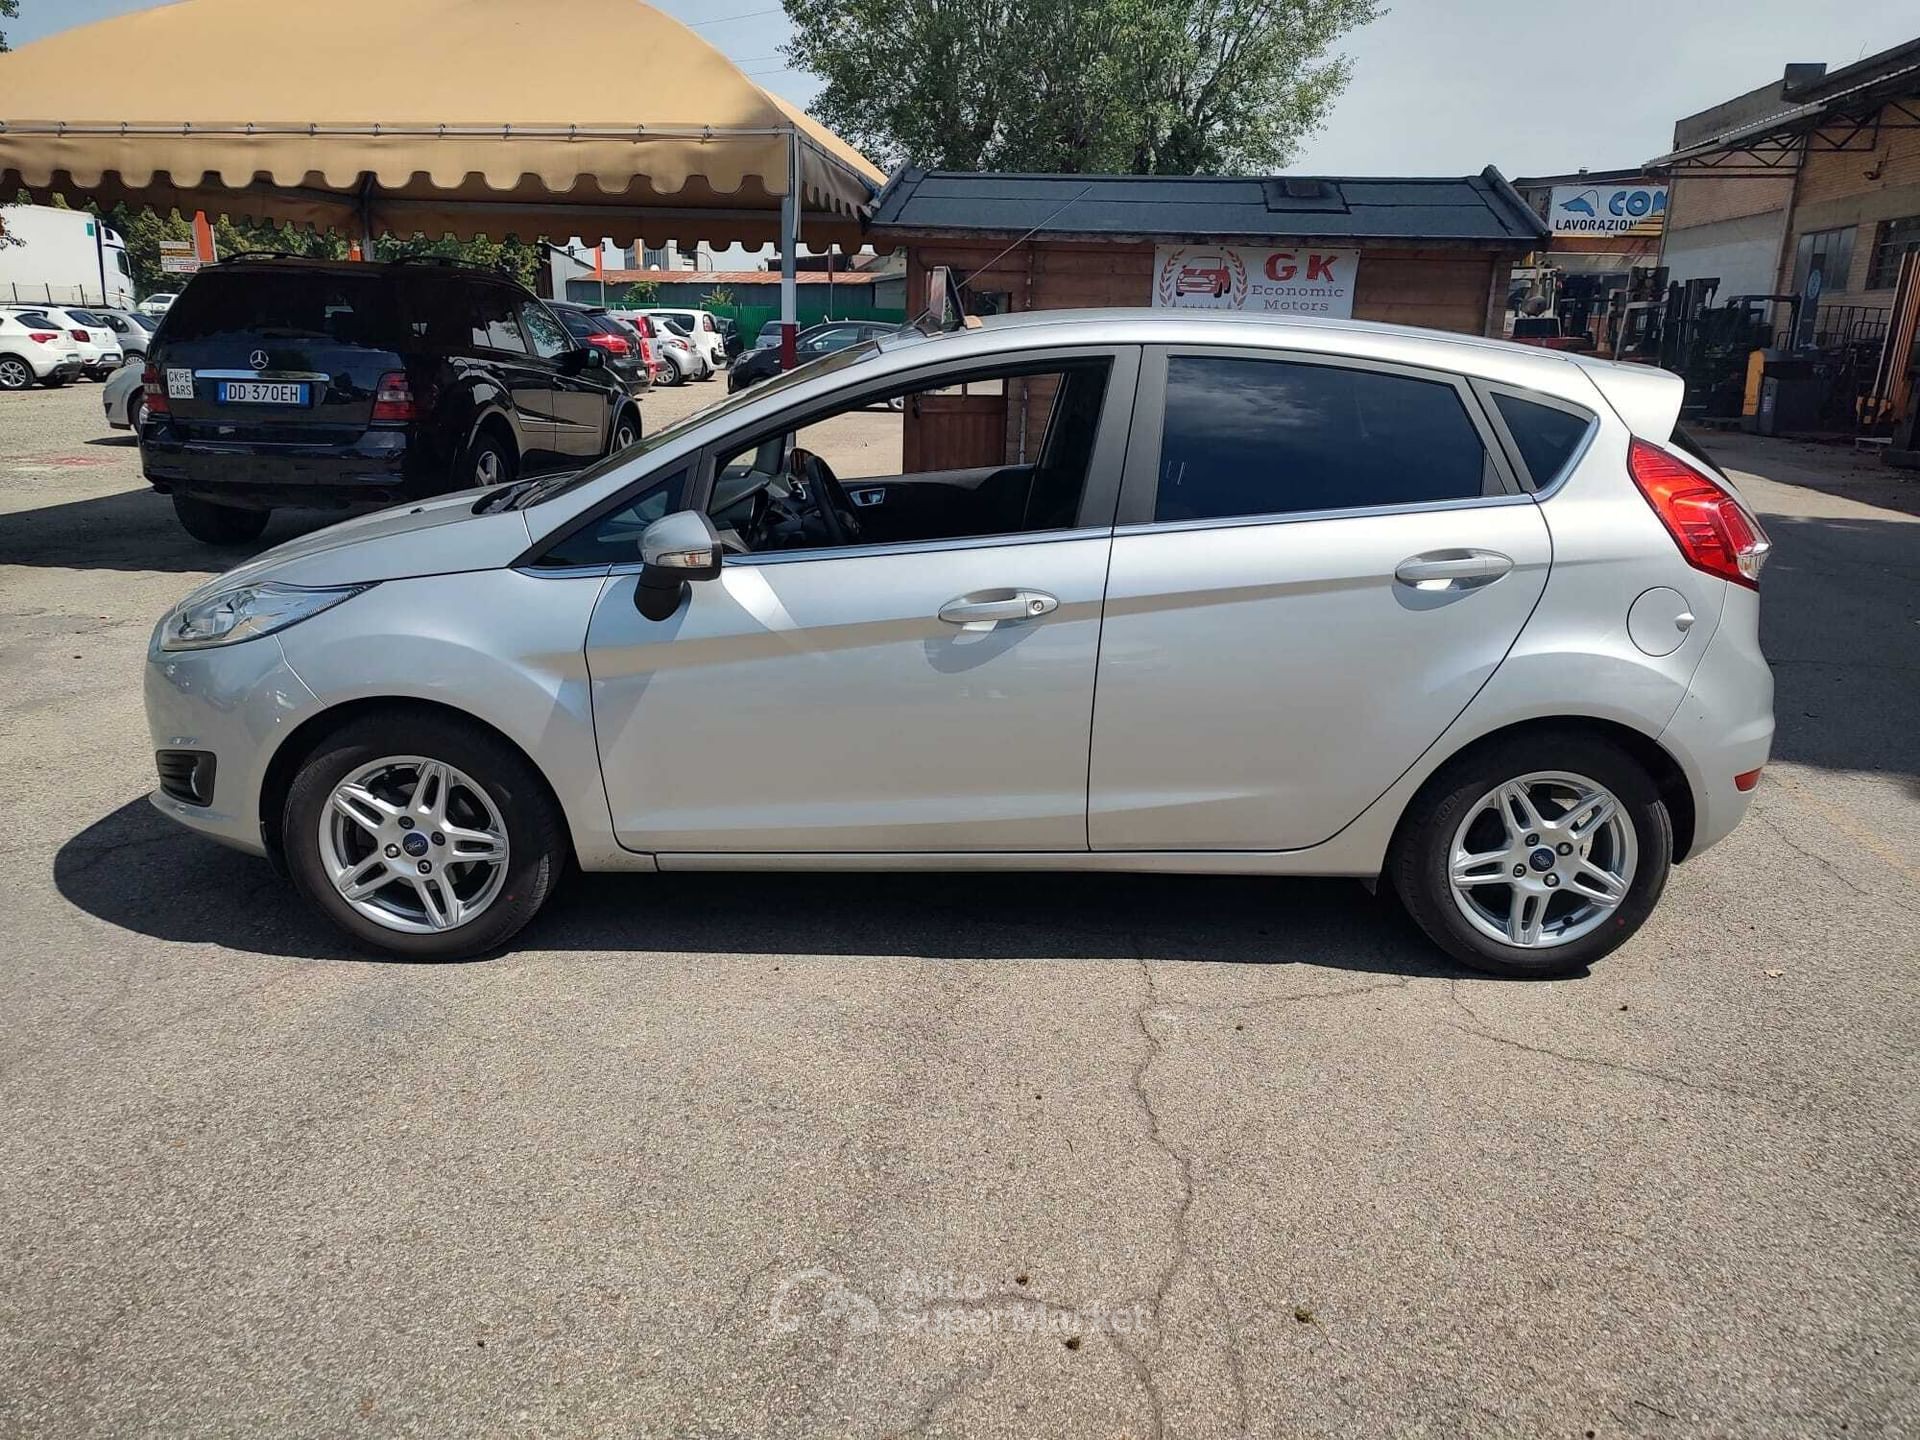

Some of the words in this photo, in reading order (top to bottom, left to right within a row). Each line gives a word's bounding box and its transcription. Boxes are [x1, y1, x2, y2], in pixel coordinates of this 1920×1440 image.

[1264, 253, 1339, 282] GK
[1251, 284, 1344, 298] Economic
[1264, 300, 1329, 311] Motors
[169, 384, 192, 396] CARS
